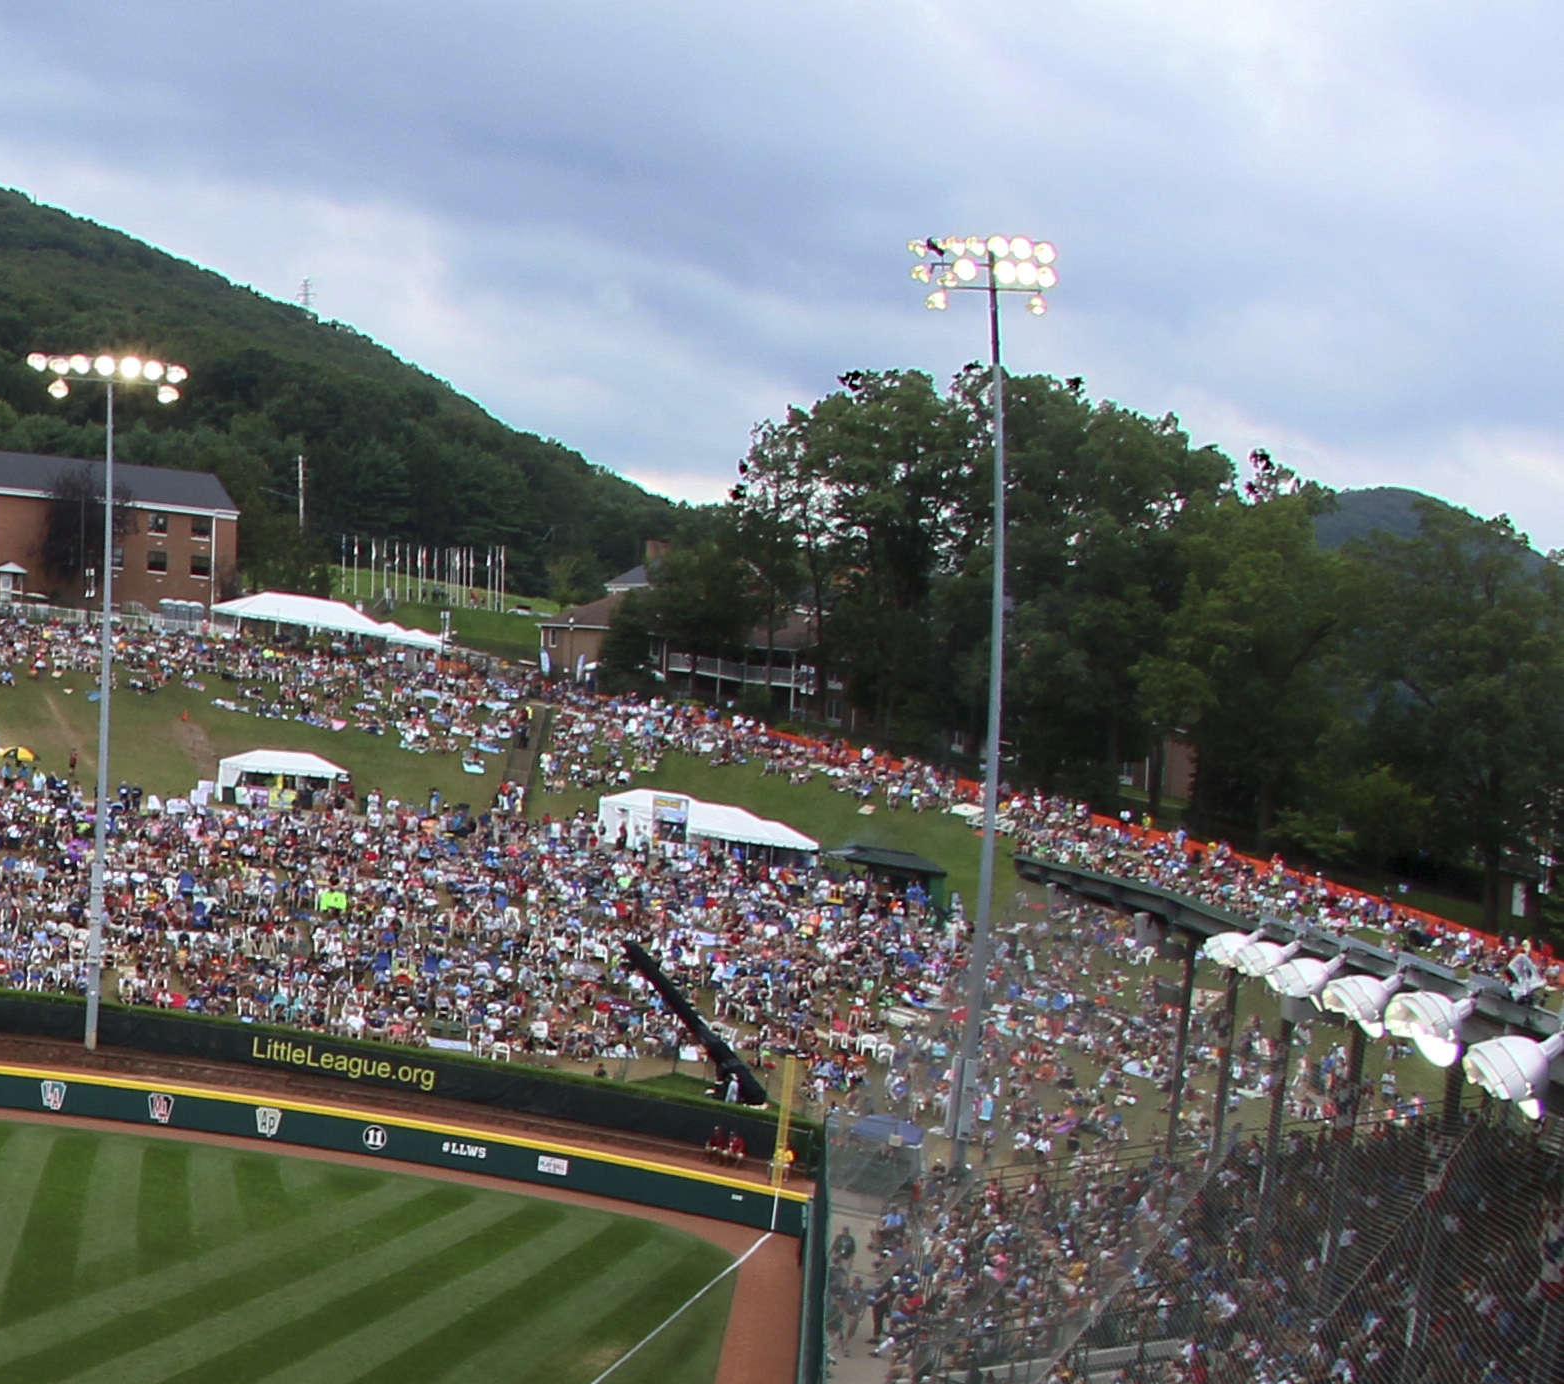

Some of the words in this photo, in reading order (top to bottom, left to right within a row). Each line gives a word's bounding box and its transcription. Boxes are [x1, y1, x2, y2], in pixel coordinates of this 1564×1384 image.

[252, 1036, 436, 1091] LittleLeague.org
[367, 1129, 384, 1147] 11
[442, 1141, 487, 1159] #LLWS
